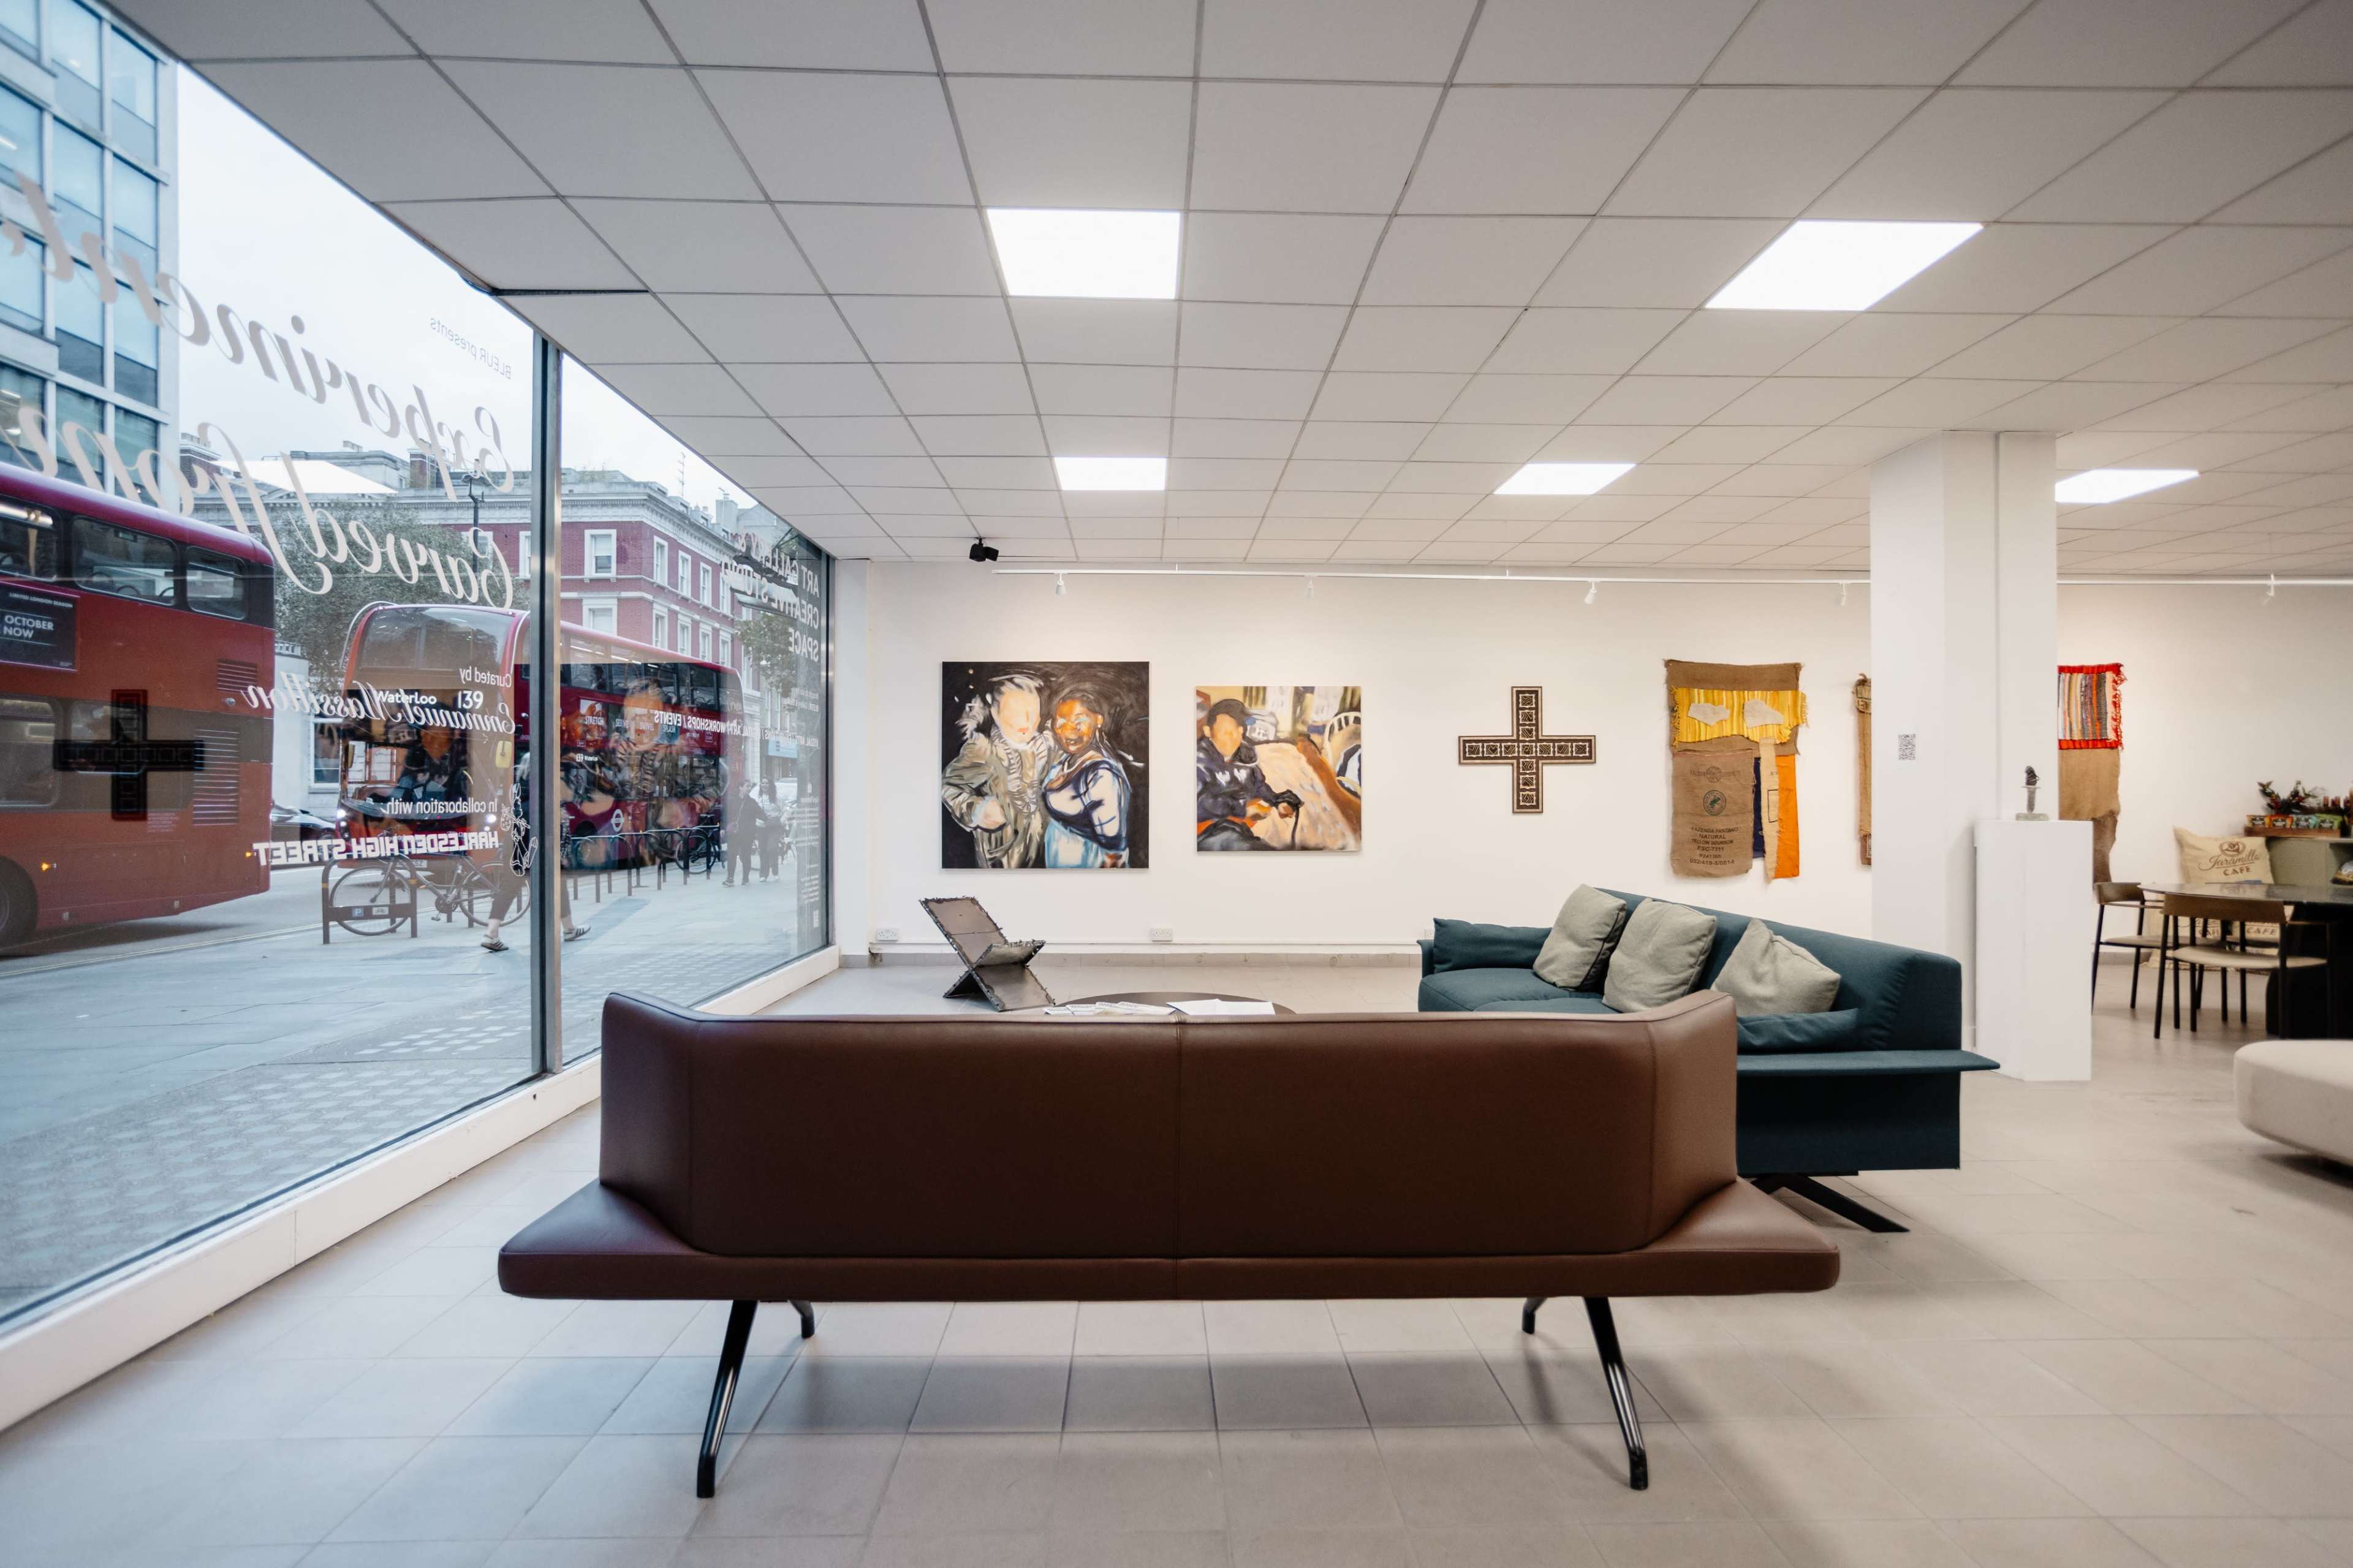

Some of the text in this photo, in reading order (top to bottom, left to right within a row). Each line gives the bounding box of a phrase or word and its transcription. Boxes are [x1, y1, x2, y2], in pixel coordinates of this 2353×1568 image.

[4, 615, 55, 631] OCTOBER
[3, 626, 34, 638] NOW
[376, 690, 438, 705] Waterloo
[457, 690, 484, 710] 139
[2198, 849, 2260, 871] Jaramillo
[2222, 865, 2252, 876] CAFE
[2246, 926, 2278, 936] CAFE
